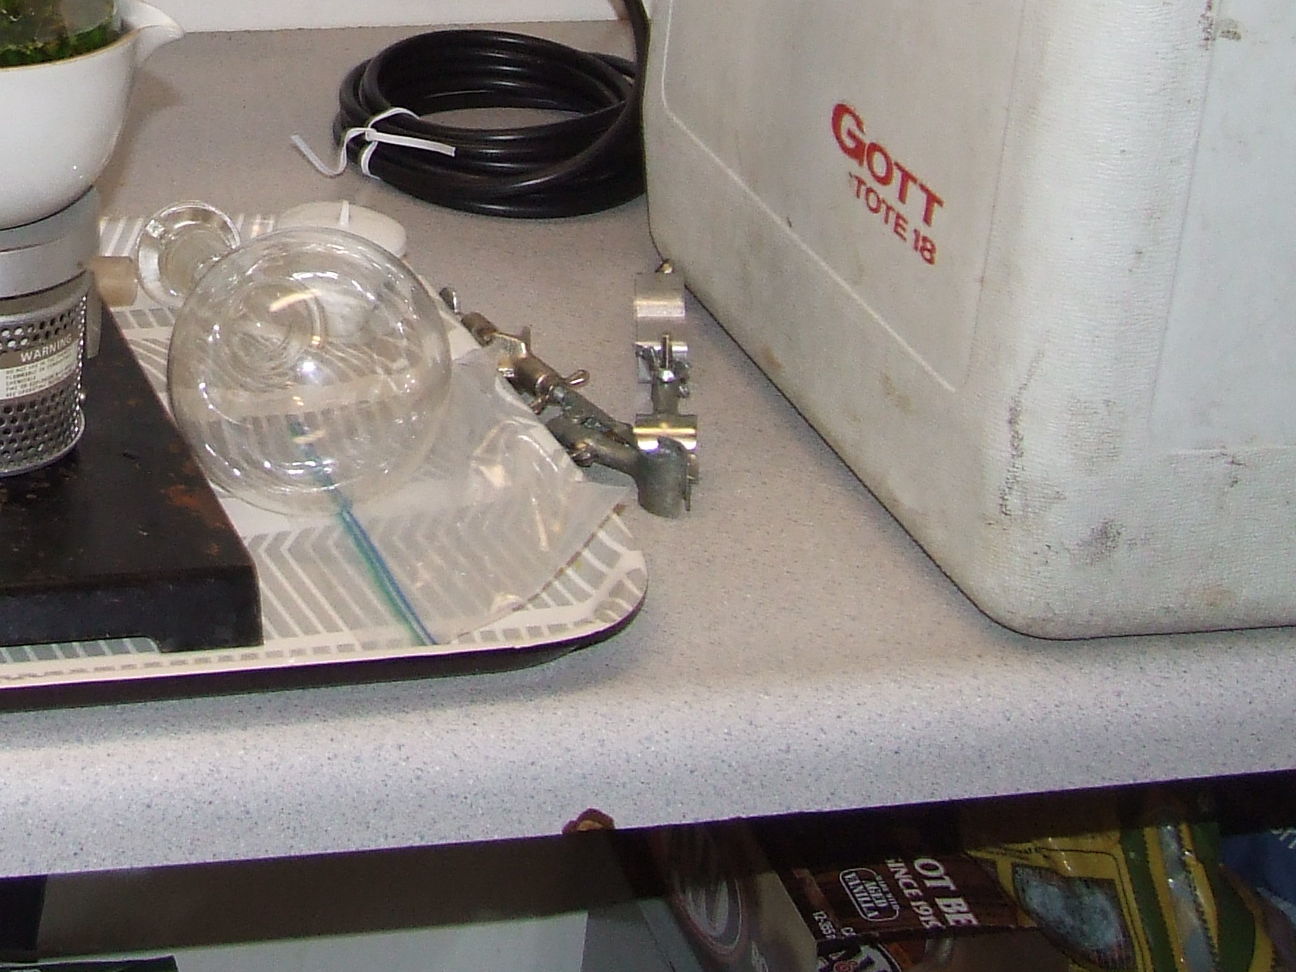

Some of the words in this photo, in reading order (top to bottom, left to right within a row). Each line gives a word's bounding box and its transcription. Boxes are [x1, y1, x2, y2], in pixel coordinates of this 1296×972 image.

[831, 103, 945, 227] GOTT
[852, 174, 909, 243] TOTE
[912, 229, 937, 266] 18
[20, 333, 72, 362] WARNING
[913, 858, 956, 891] OT
[844, 872, 880, 919] VANILLA
[934, 897, 980, 927] BE
